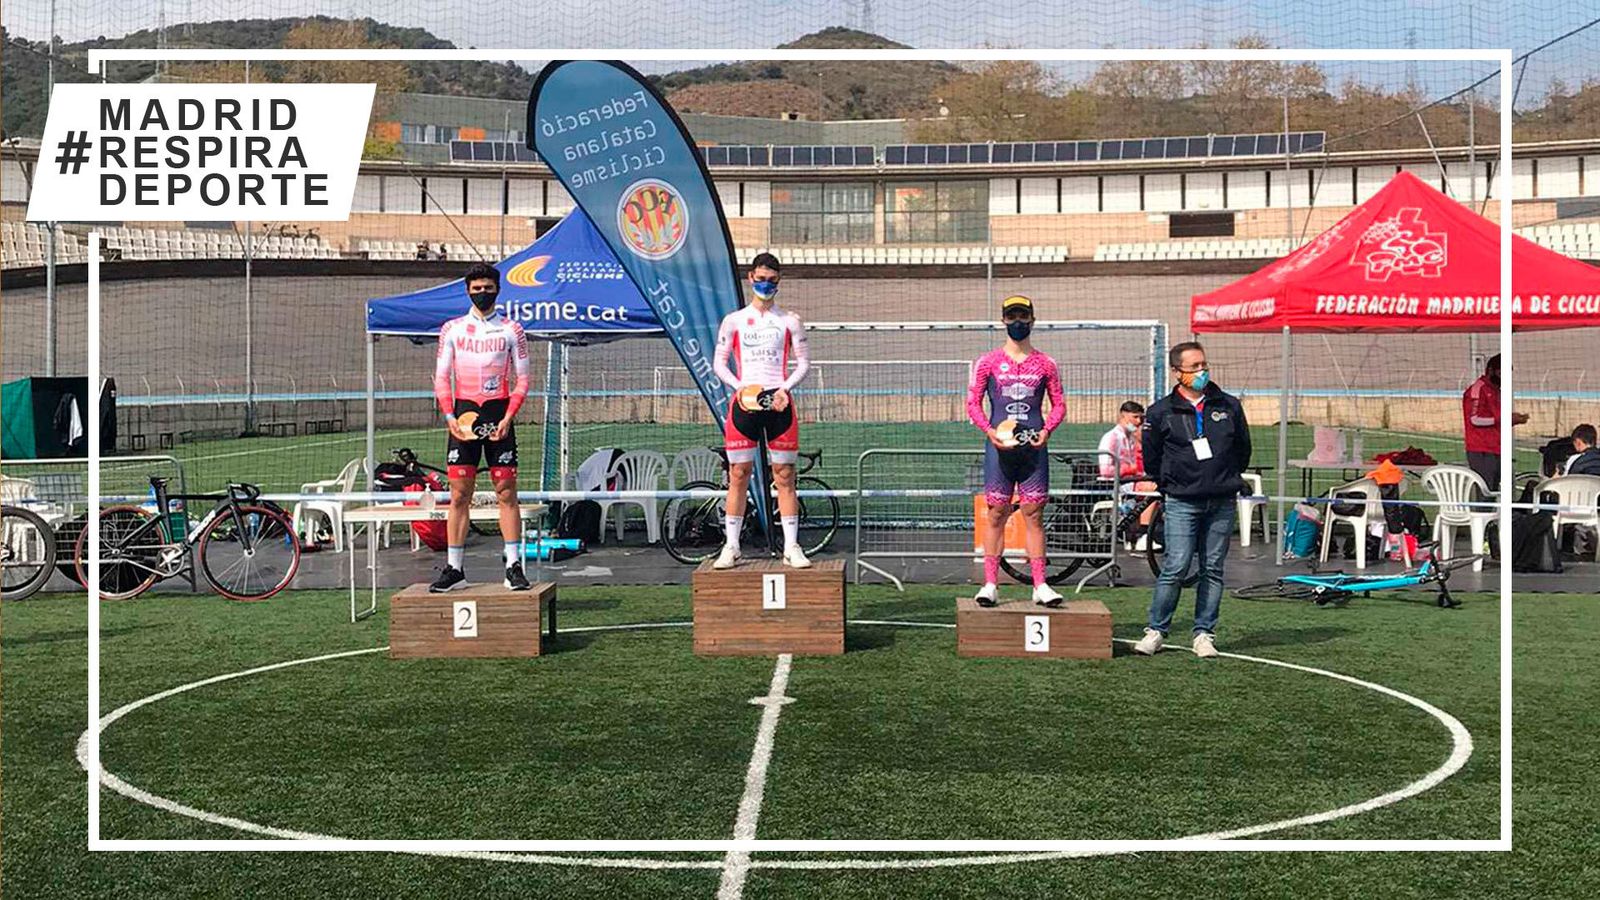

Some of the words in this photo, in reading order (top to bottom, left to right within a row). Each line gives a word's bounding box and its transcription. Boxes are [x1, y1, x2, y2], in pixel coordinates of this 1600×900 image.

[559, 261, 623, 269] FEDERACI
[1315, 293, 1419, 315] FEDERACIÓN
[1426, 295, 1522, 315] MADRILEA
[1529, 294, 1551, 314] DE
[456, 336, 507, 353] MADRID
[769, 579, 778, 603] 1
[458, 607, 474, 631] 2
[1030, 621, 1045, 646] 3
